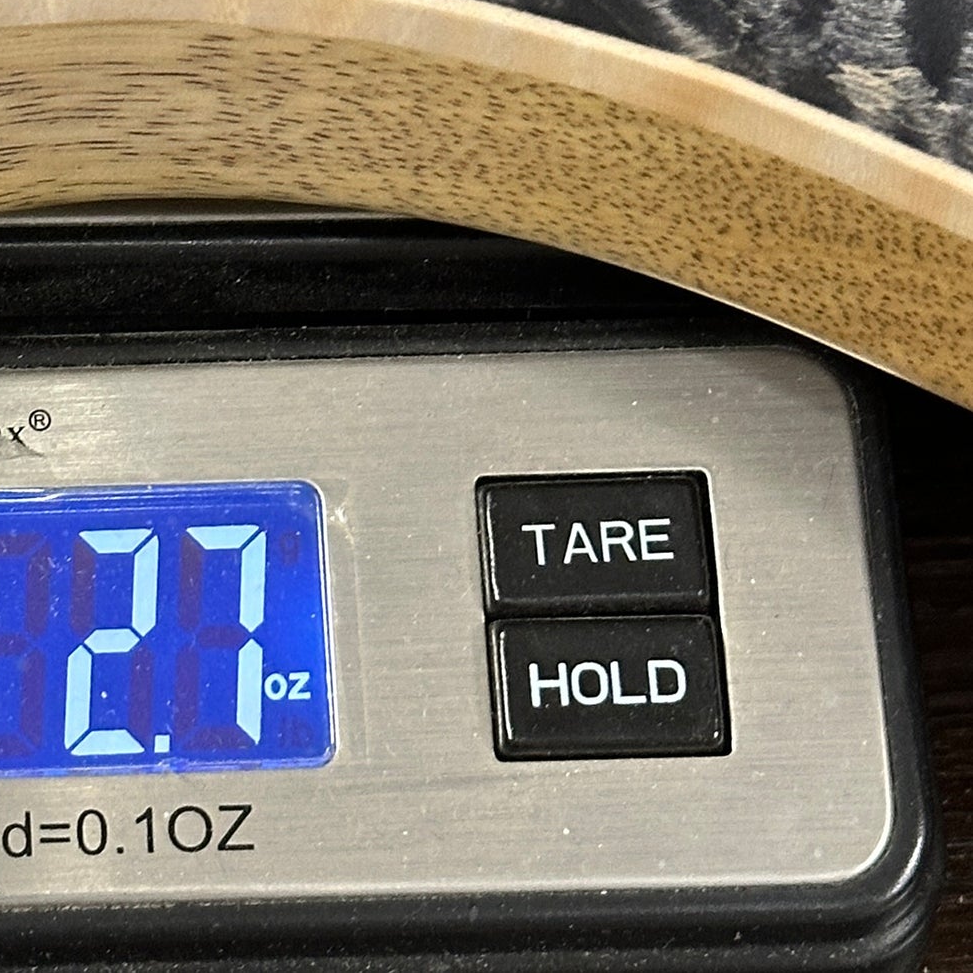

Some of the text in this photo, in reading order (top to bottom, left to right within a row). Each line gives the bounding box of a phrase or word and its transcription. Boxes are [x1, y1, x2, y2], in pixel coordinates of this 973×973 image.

[520, 517, 675, 566] TARE
[263, 671, 312, 701] oz
[528, 658, 688, 708] HOLD
